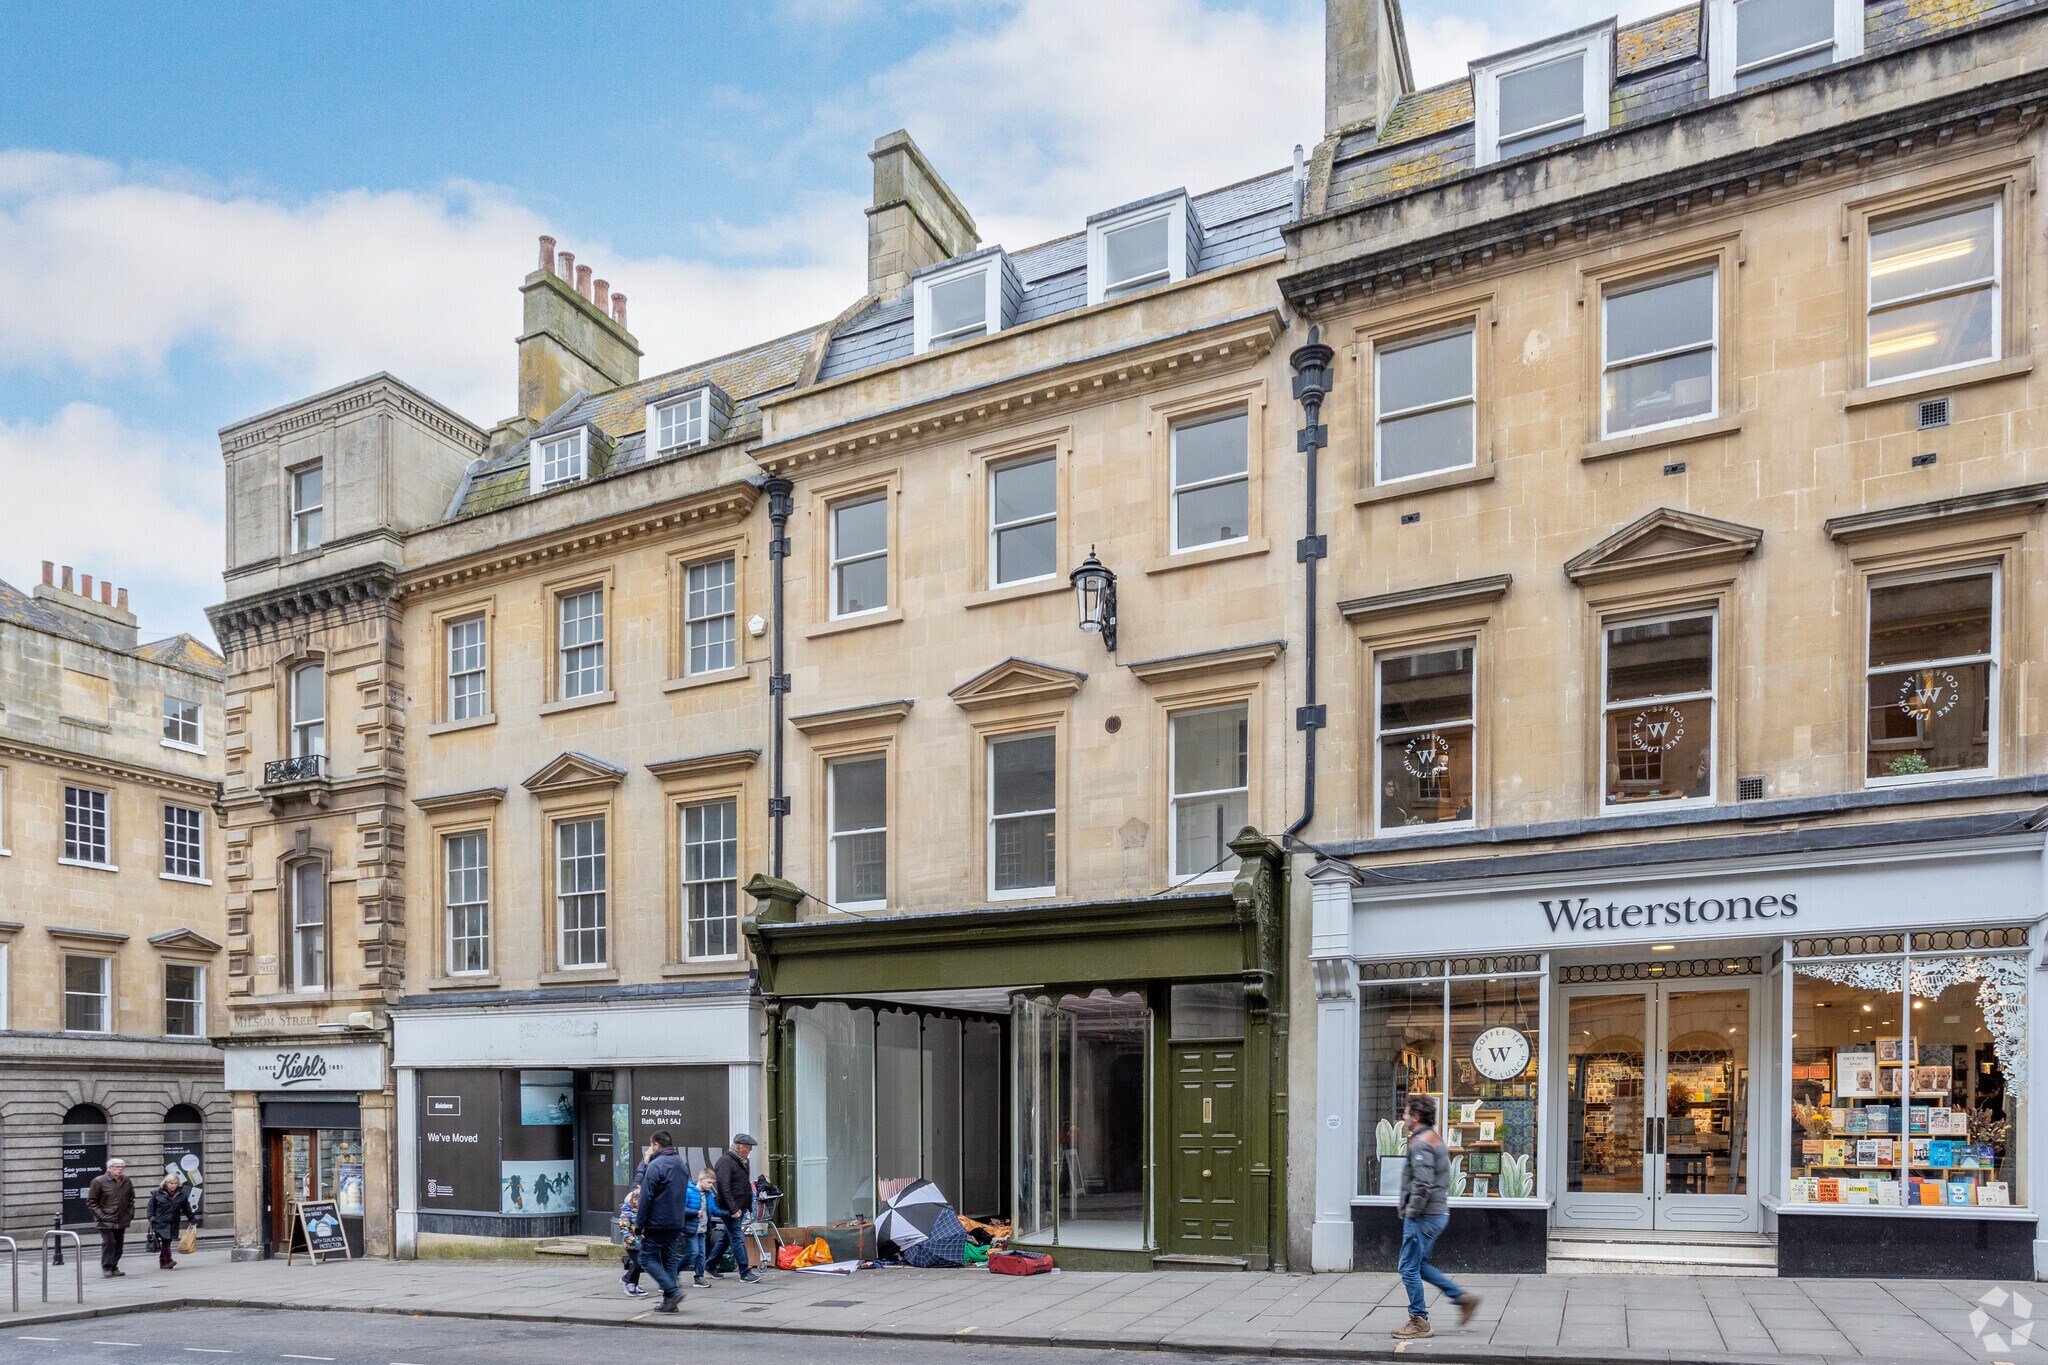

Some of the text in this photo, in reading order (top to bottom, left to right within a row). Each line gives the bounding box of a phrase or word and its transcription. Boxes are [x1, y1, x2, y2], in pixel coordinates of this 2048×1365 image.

[1538, 892, 1798, 933] Waterstones
[234, 1014, 320, 1028] MILSOM STREET
[1476, 1030, 1524, 1051] COFFEE TEA
[1488, 1046, 1512, 1062] W
[272, 1052, 326, 1081] Kiehl's
[1476, 1058, 1493, 1077] CAKE
[1500, 1056, 1526, 1078] LUNCH
[428, 1133, 478, 1142] We've Moved
